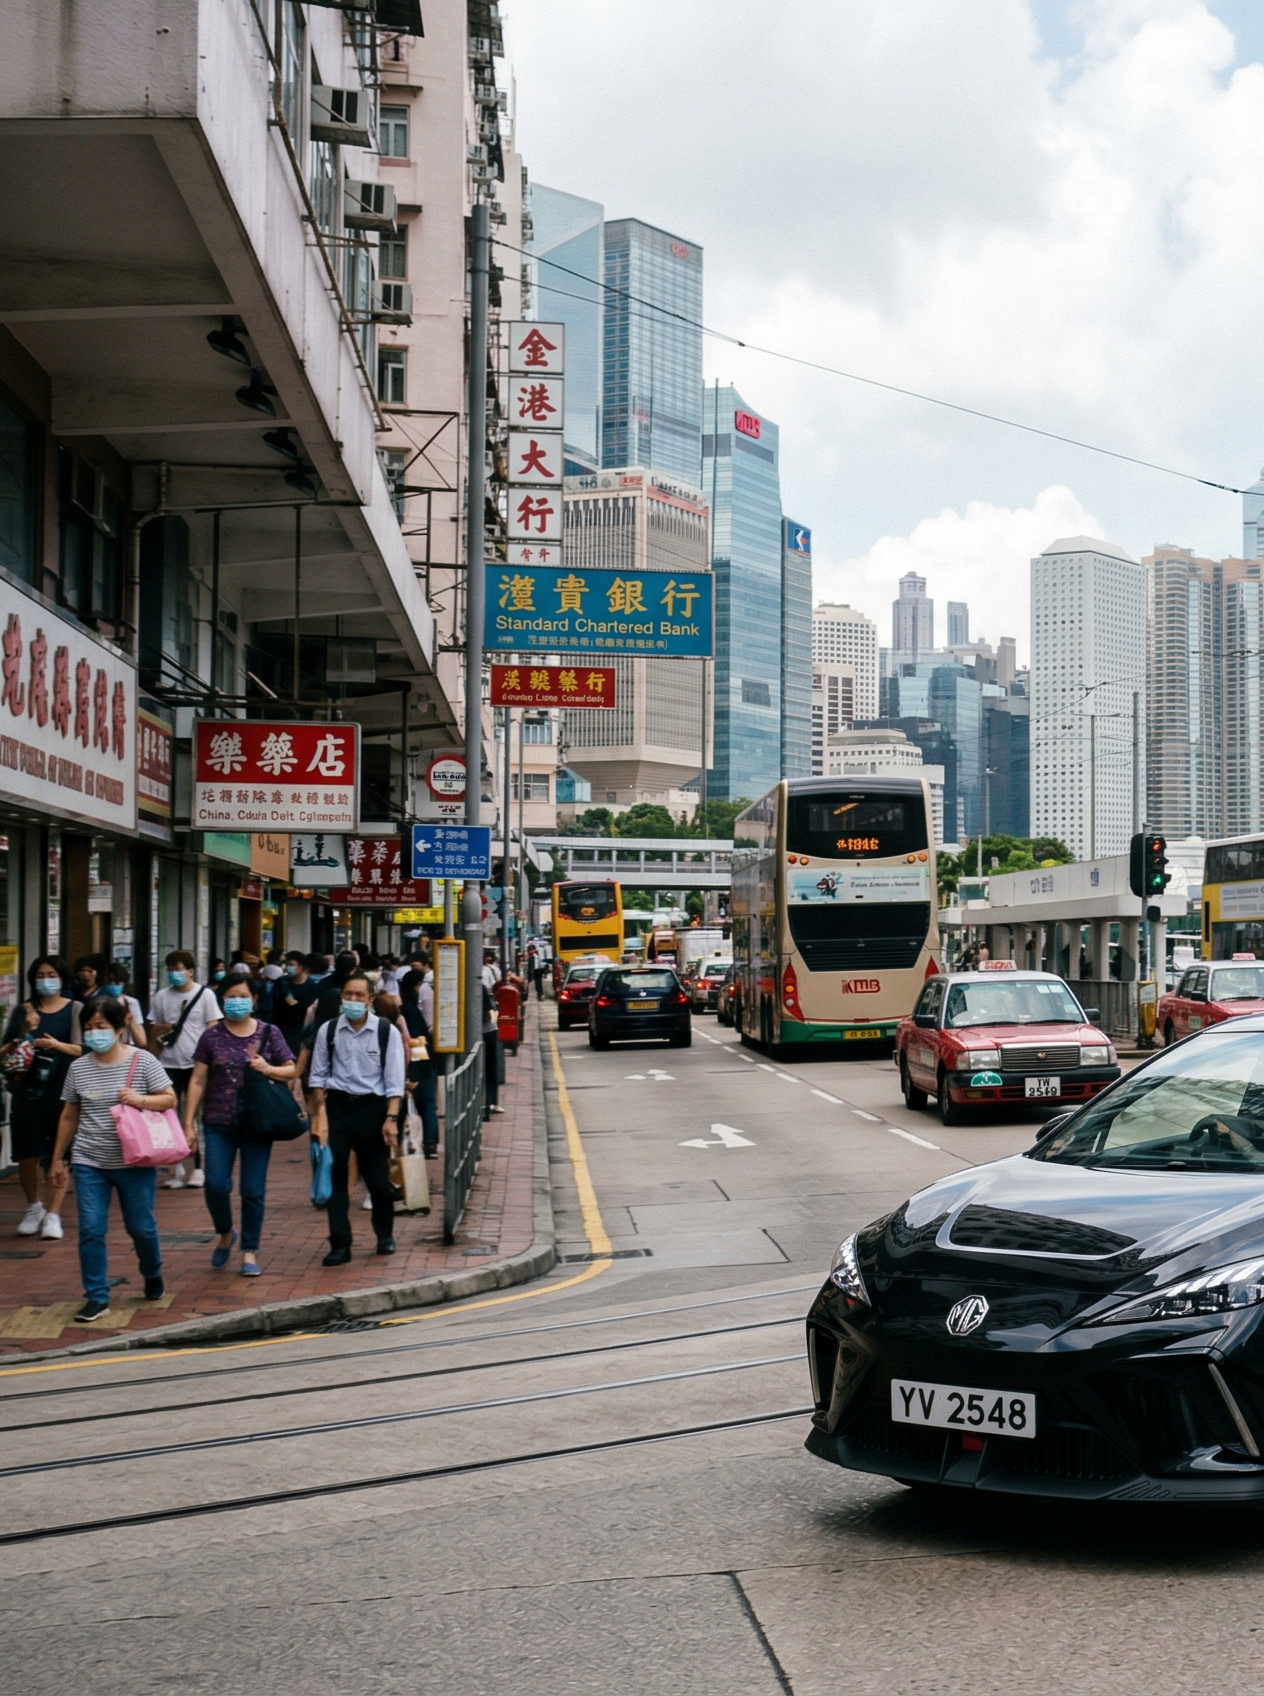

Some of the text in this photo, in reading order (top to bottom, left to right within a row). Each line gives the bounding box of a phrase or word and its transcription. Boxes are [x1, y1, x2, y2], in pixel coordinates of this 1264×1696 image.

[516, 327, 558, 534] 金港大行
[495, 615, 700, 636] Standard Chartered Bank
[842, 979, 881, 994] KMB
[1037, 1078, 1050, 1086] YW
[949, 1297, 988, 1335] MG
[900, 1386, 1027, 1430] YV 2548
